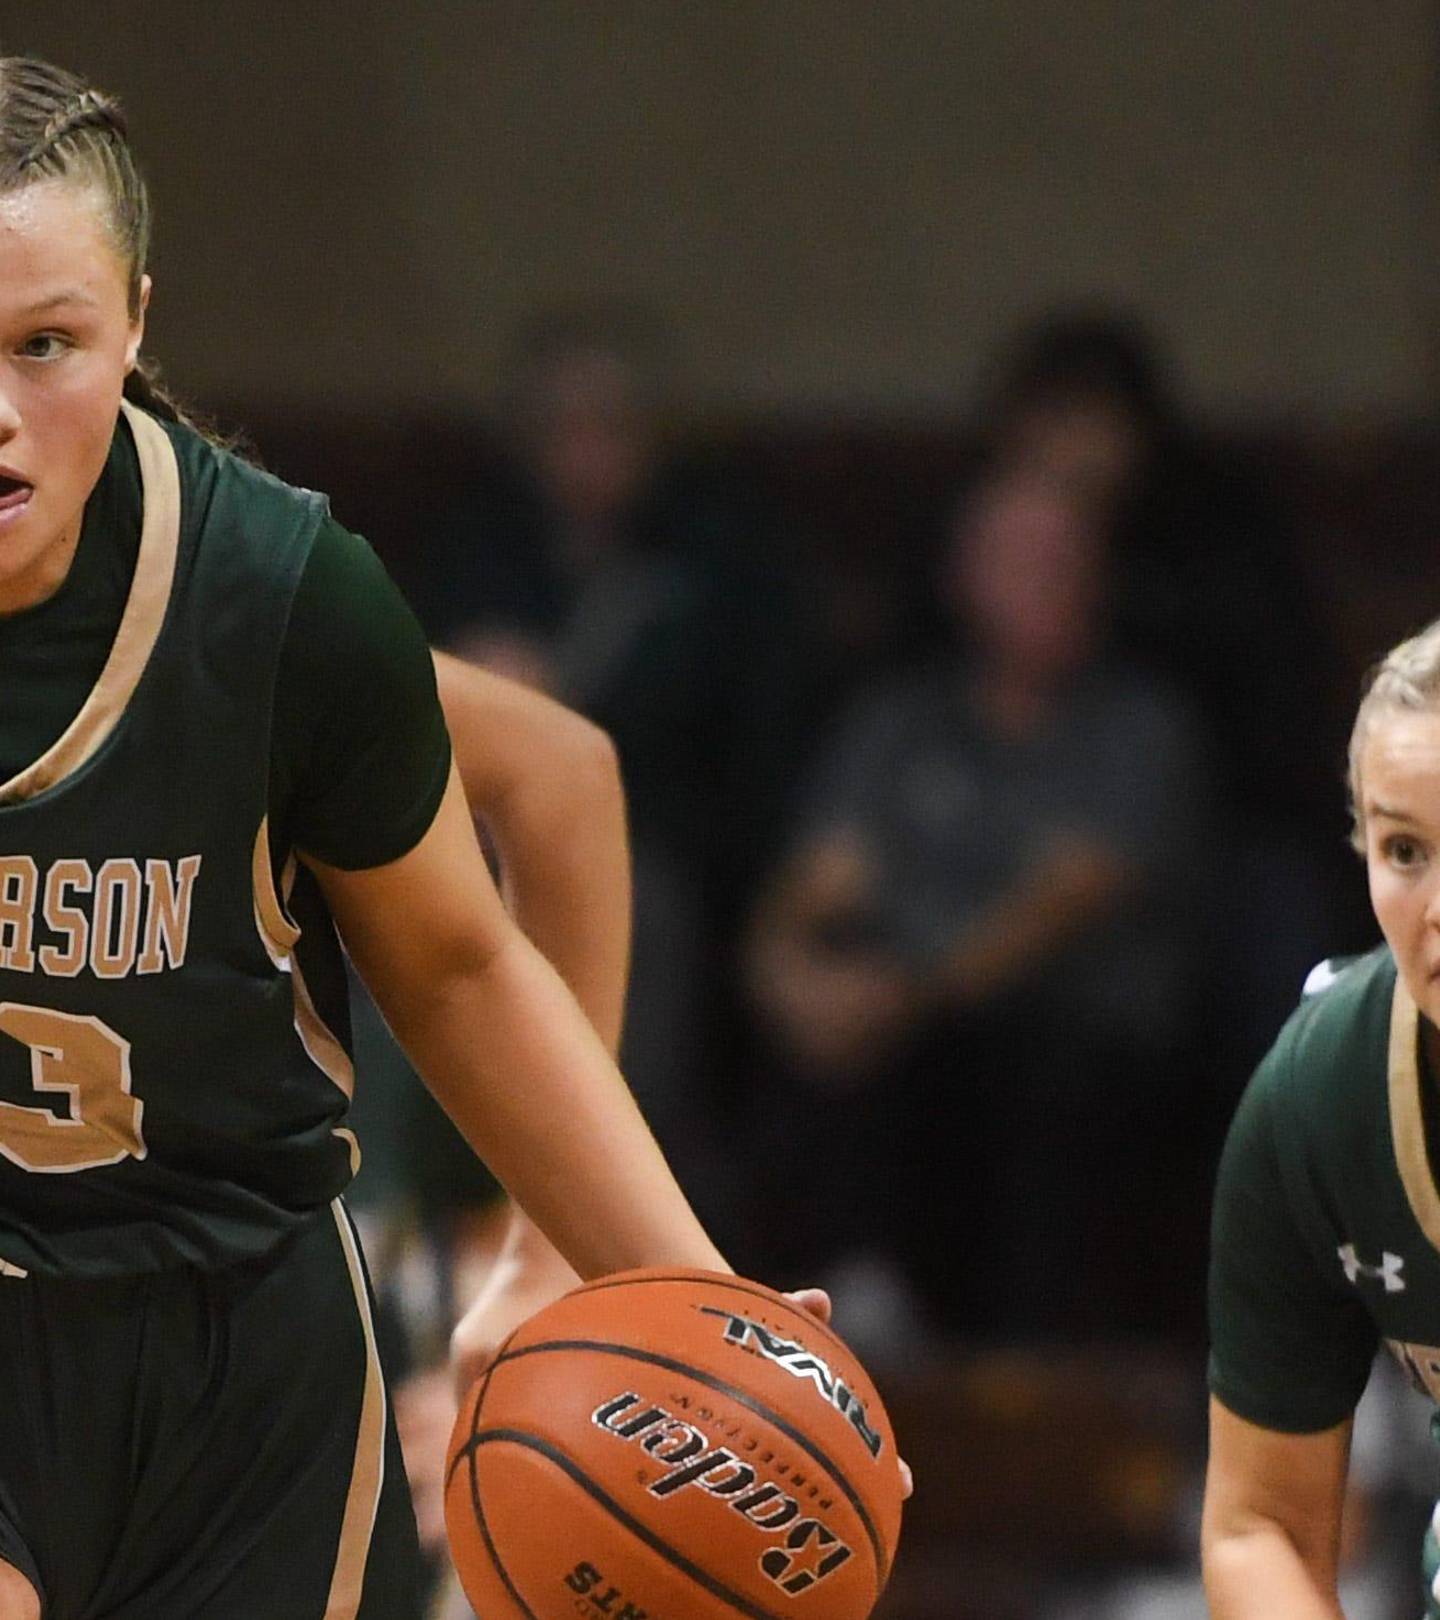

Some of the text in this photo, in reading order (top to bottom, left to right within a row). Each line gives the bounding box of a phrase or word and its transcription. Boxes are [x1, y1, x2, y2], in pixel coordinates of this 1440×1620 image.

[671, 1392, 833, 1511] PERFECTION
[699, 1305, 882, 1461] RIVAL
[591, 1391, 854, 1598] Baden
